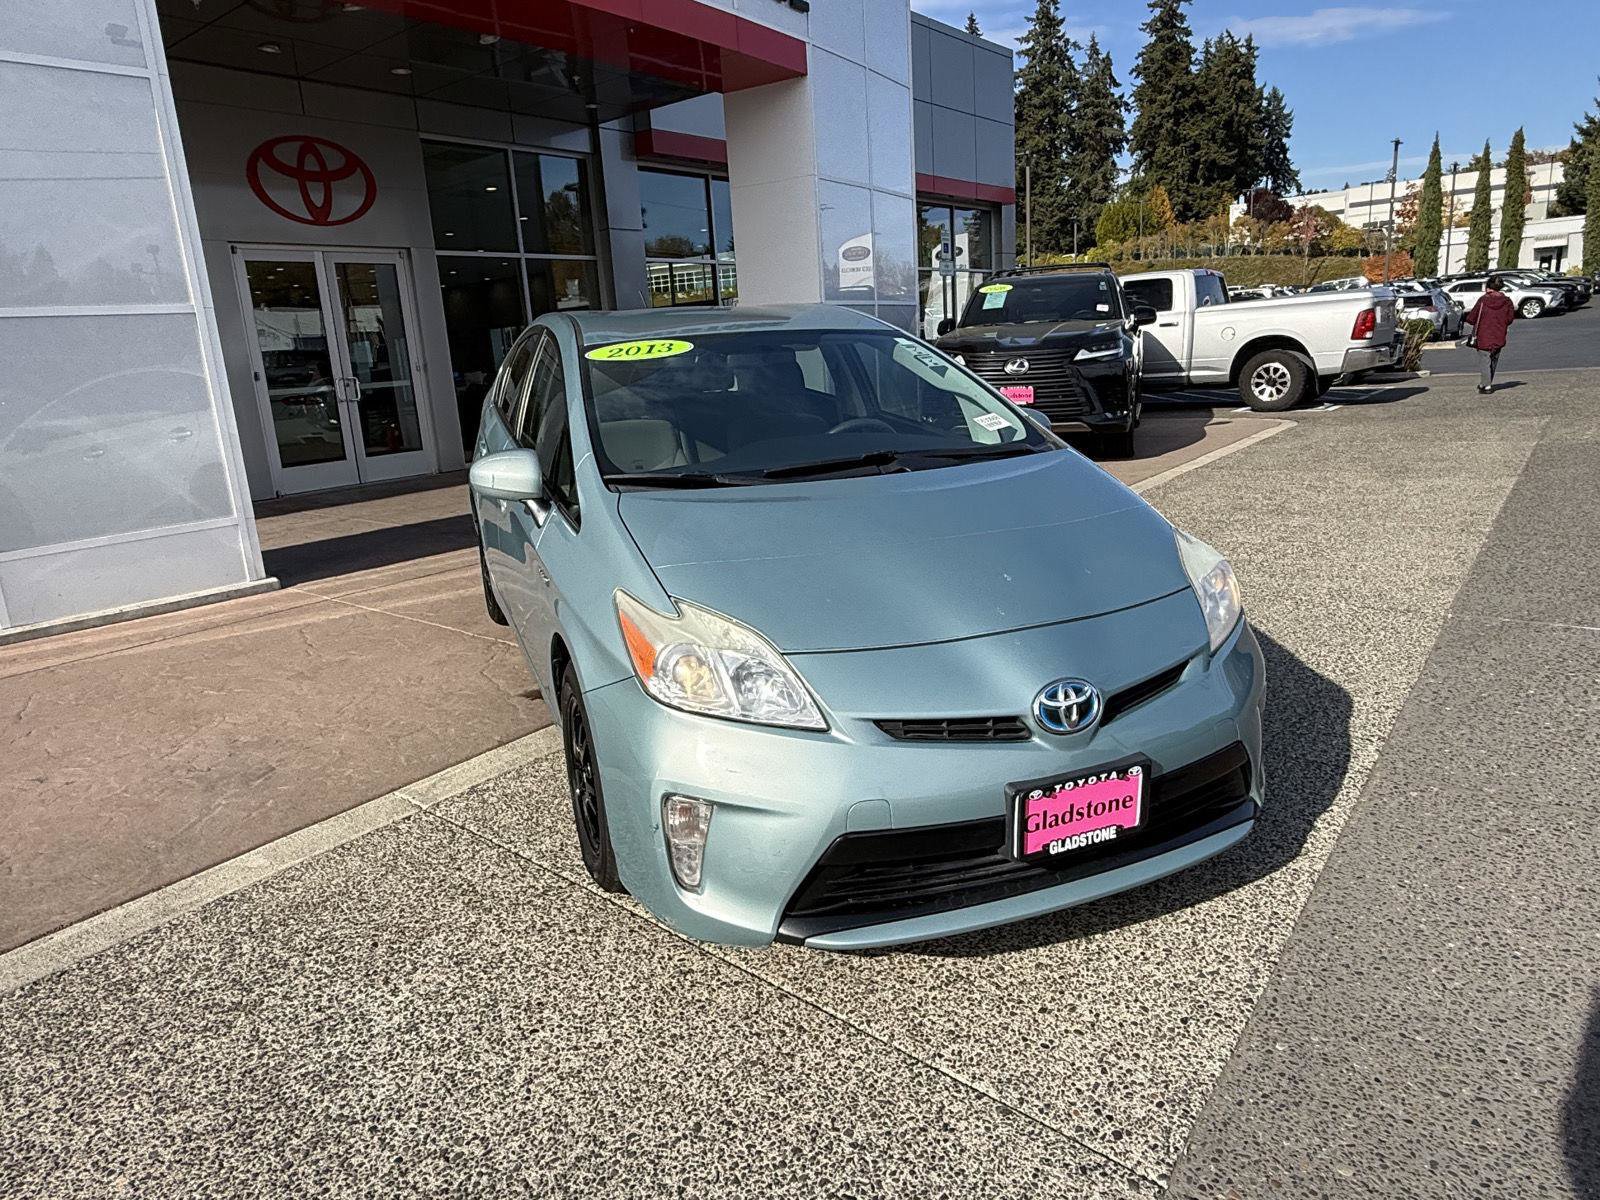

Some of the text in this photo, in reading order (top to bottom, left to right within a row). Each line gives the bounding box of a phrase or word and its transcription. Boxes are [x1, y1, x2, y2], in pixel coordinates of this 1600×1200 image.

[607, 342, 674, 358] 2013
[1054, 771, 1118, 793] TOYOTA
[1025, 795, 1134, 833] Gladstone
[1049, 826, 1117, 855] GLADSTONE
